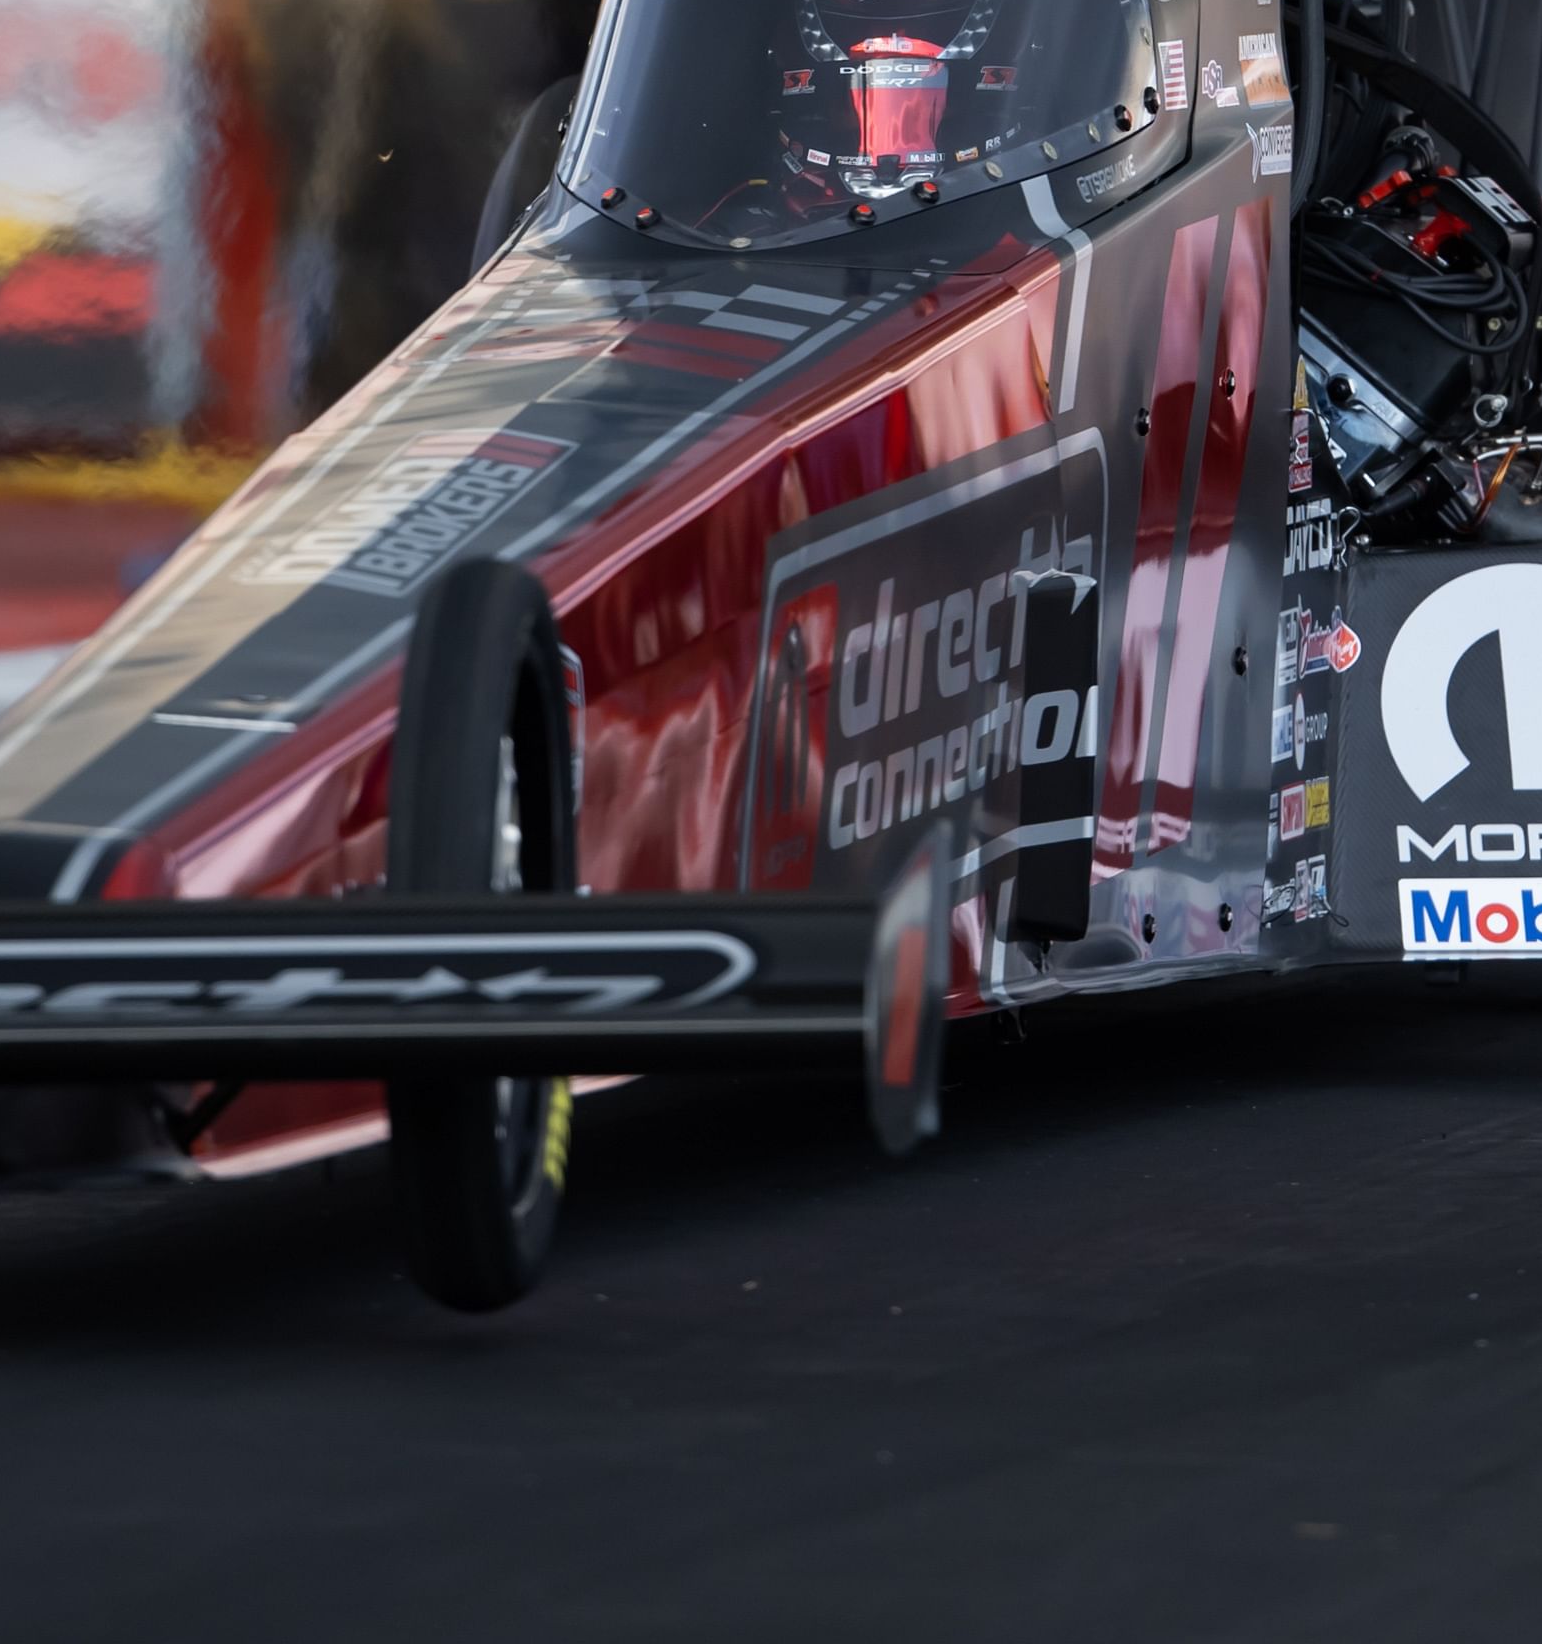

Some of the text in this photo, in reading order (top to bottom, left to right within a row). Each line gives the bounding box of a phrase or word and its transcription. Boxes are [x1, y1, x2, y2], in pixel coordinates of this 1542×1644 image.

[839, 64, 930, 75] DODGE
[870, 77, 923, 88] SRT
[353, 458, 537, 584] BROKERS
[1306, 711, 1328, 743] GROUP
